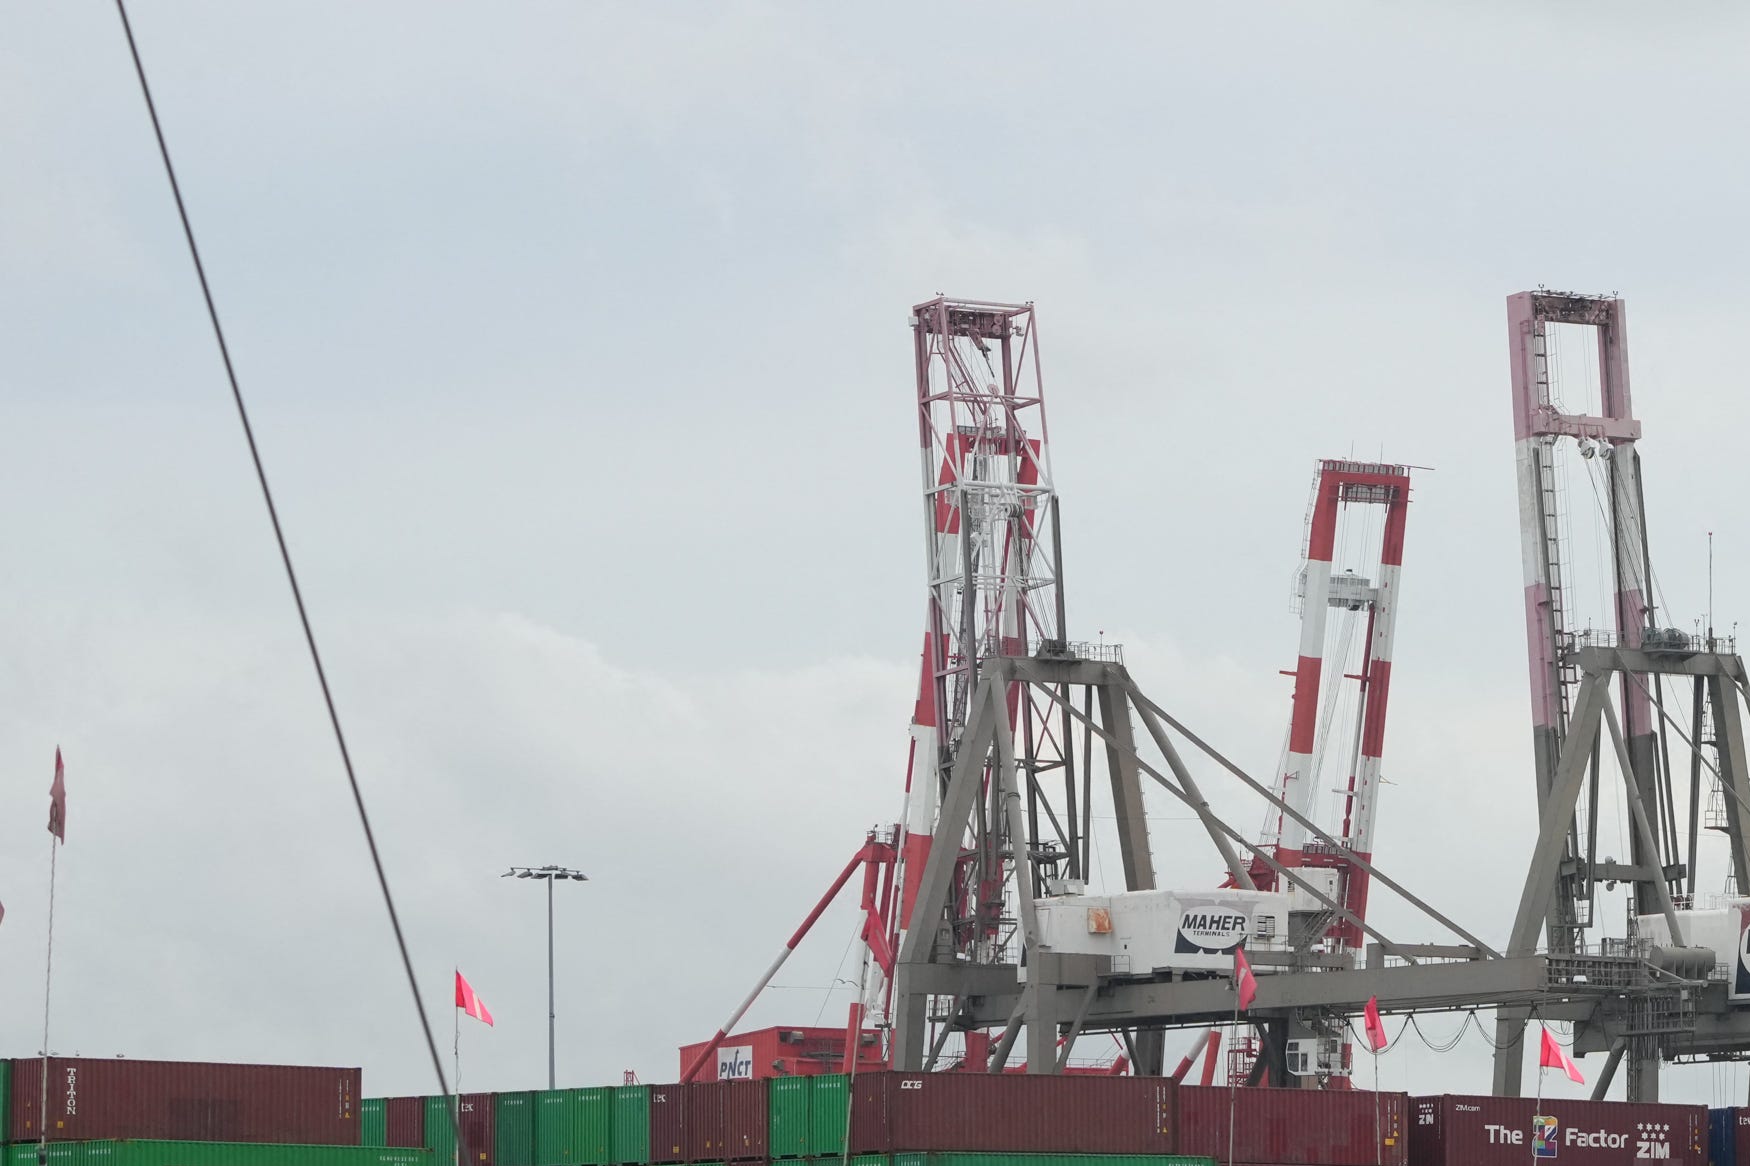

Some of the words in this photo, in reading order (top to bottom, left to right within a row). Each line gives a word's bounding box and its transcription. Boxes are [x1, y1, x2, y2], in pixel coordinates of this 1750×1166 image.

[1181, 914, 1246, 931] MAHER
[719, 1056, 751, 1080] PNCT
[66, 1067, 77, 1116] TRITON
[1484, 1124, 1524, 1145] The
[1565, 1127, 1629, 1150] Factor
[1636, 1140, 1671, 1160] ZIM
